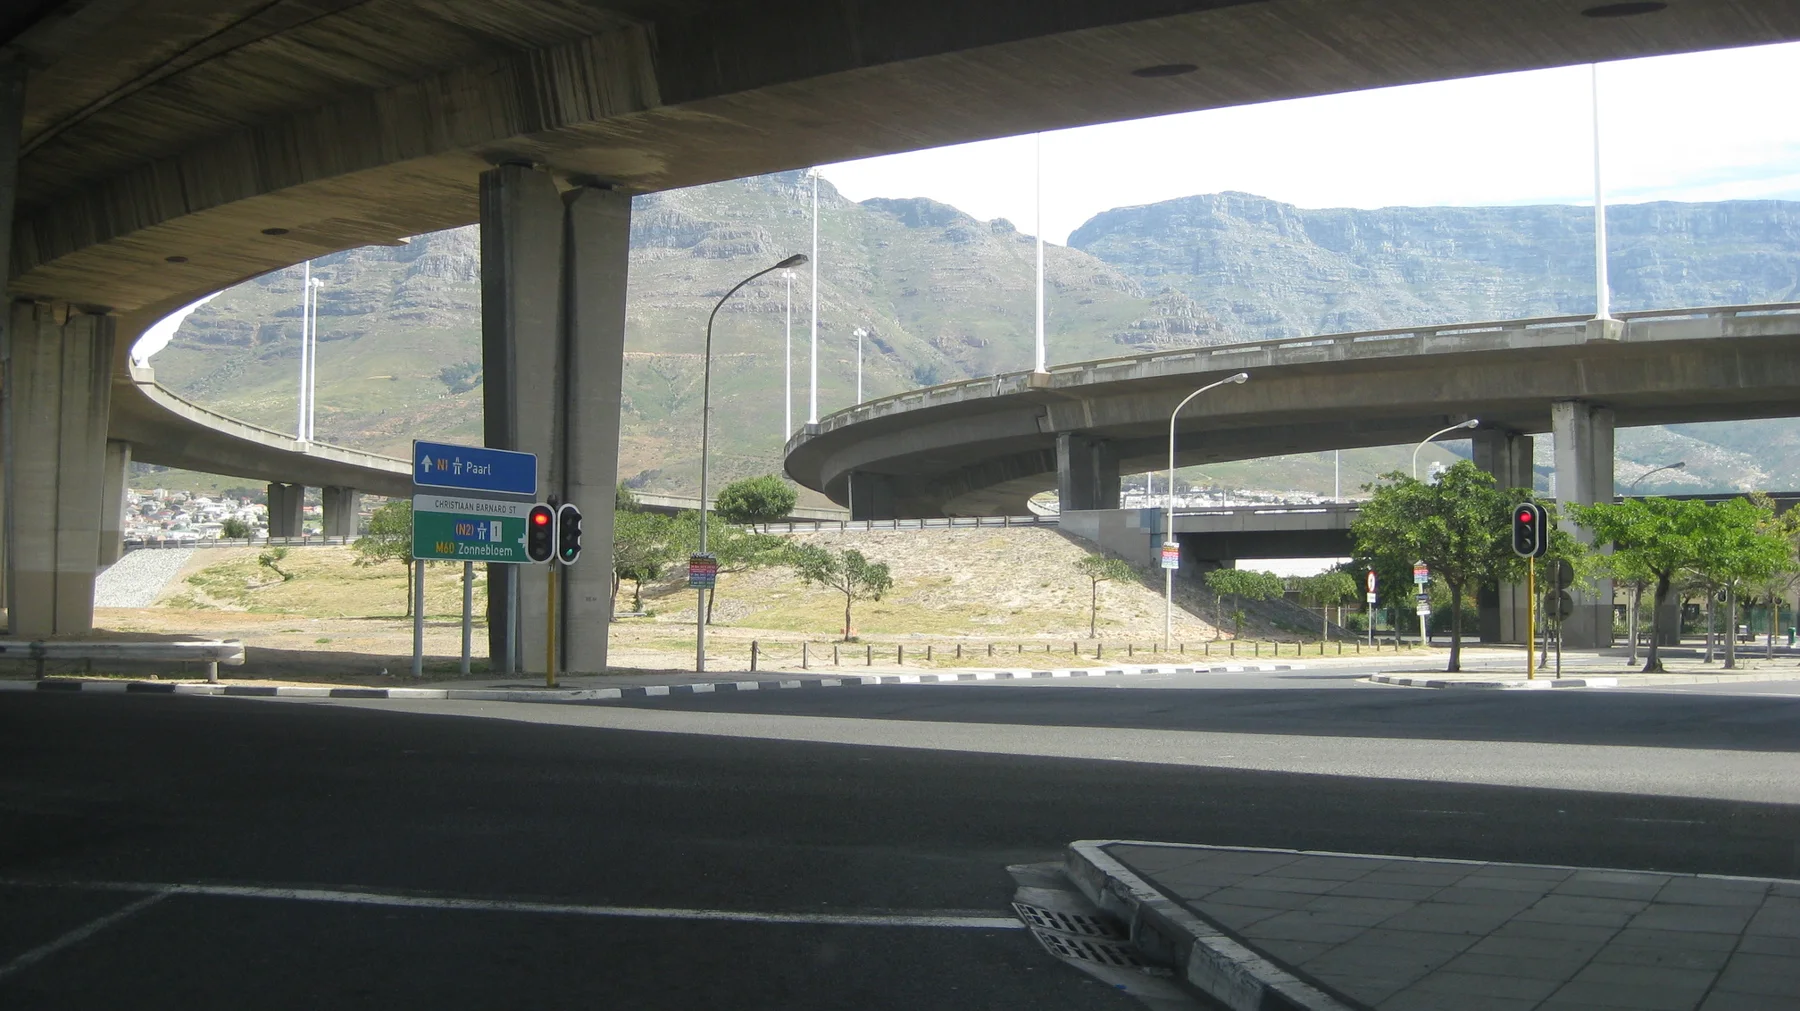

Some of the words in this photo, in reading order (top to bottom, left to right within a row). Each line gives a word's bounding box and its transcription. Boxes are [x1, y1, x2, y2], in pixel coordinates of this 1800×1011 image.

[437, 458, 448, 471] N1
[466, 461, 491, 476] Paarl
[435, 500, 474, 511] CHRISTIAAN
[476, 504, 507, 514] BARNARD
[509, 505, 517, 514] ST
[455, 523, 474, 536] (N2)
[435, 541, 455, 554] M60
[458, 542, 513, 557] Zonnebloem
